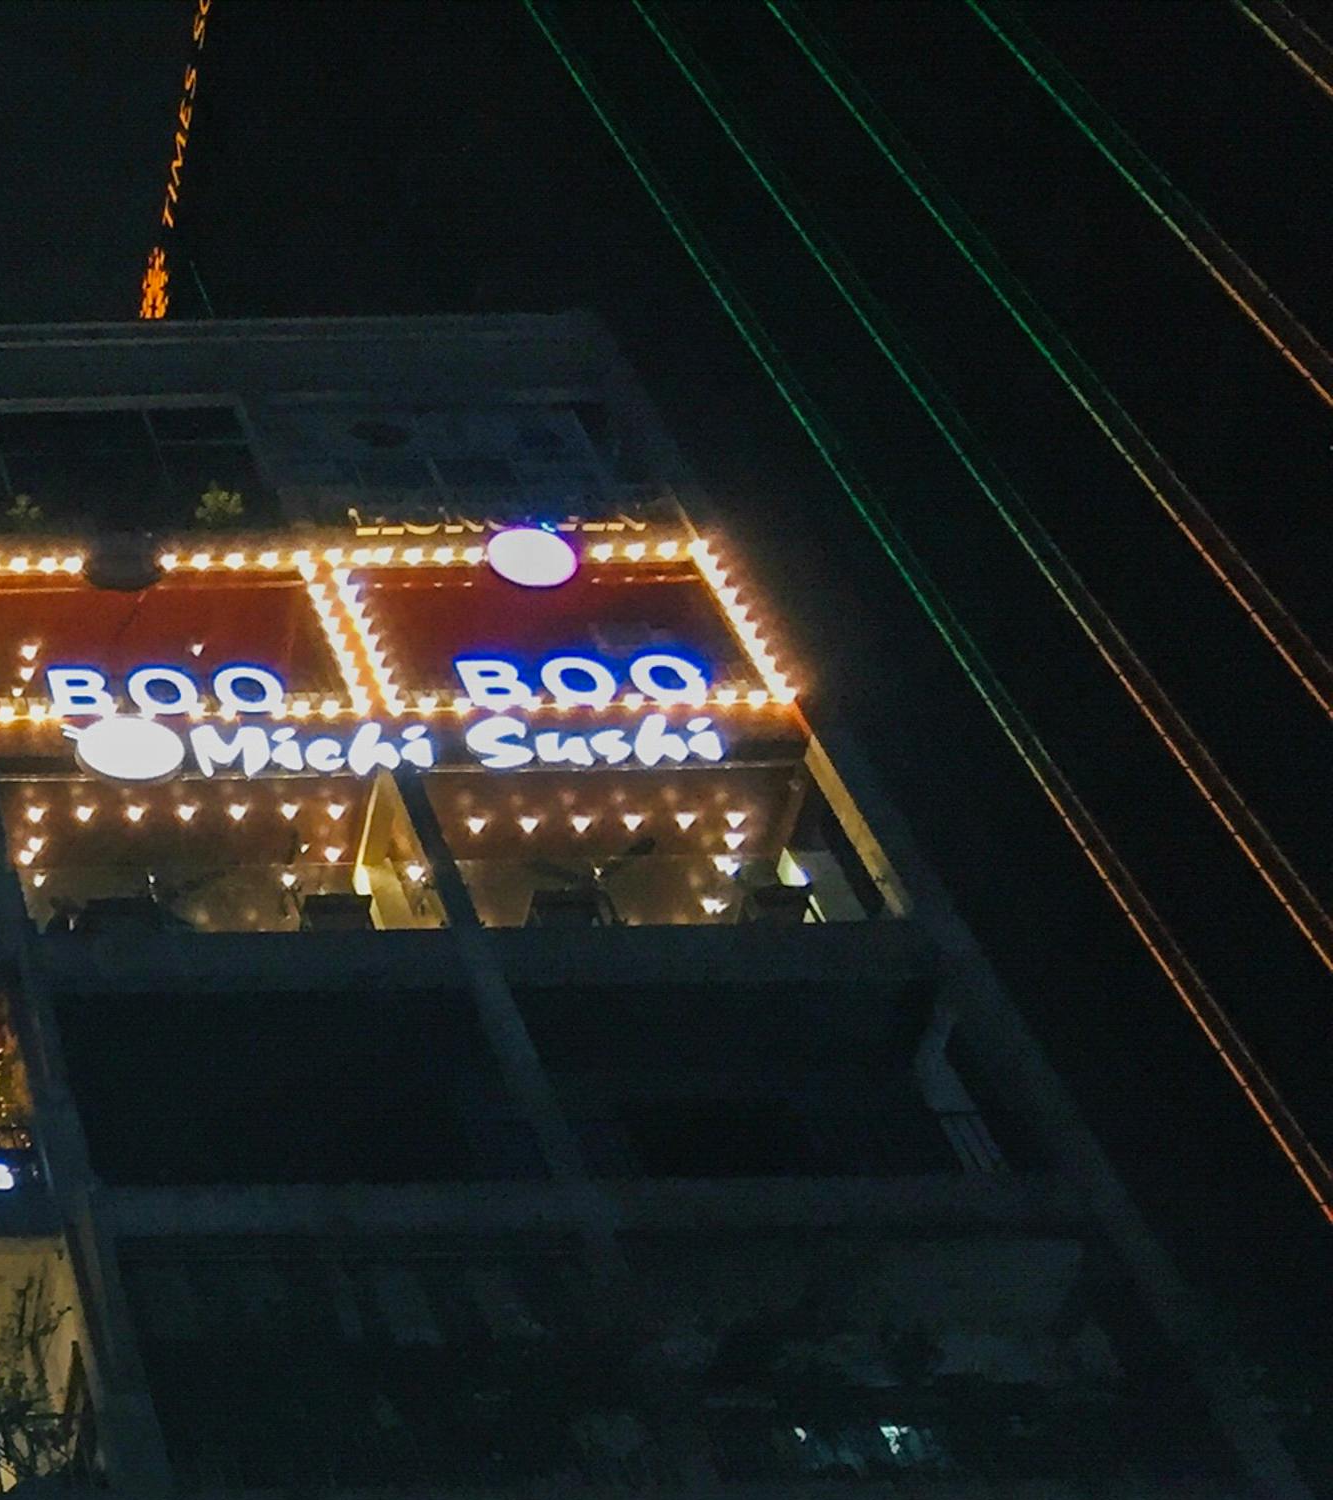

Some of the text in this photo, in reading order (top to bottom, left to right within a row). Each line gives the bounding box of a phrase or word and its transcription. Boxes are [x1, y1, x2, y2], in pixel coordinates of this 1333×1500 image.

[45, 666, 287, 718] BOO
[453, 654, 711, 710] BOO
[190, 713, 726, 778] Michi Sushi
